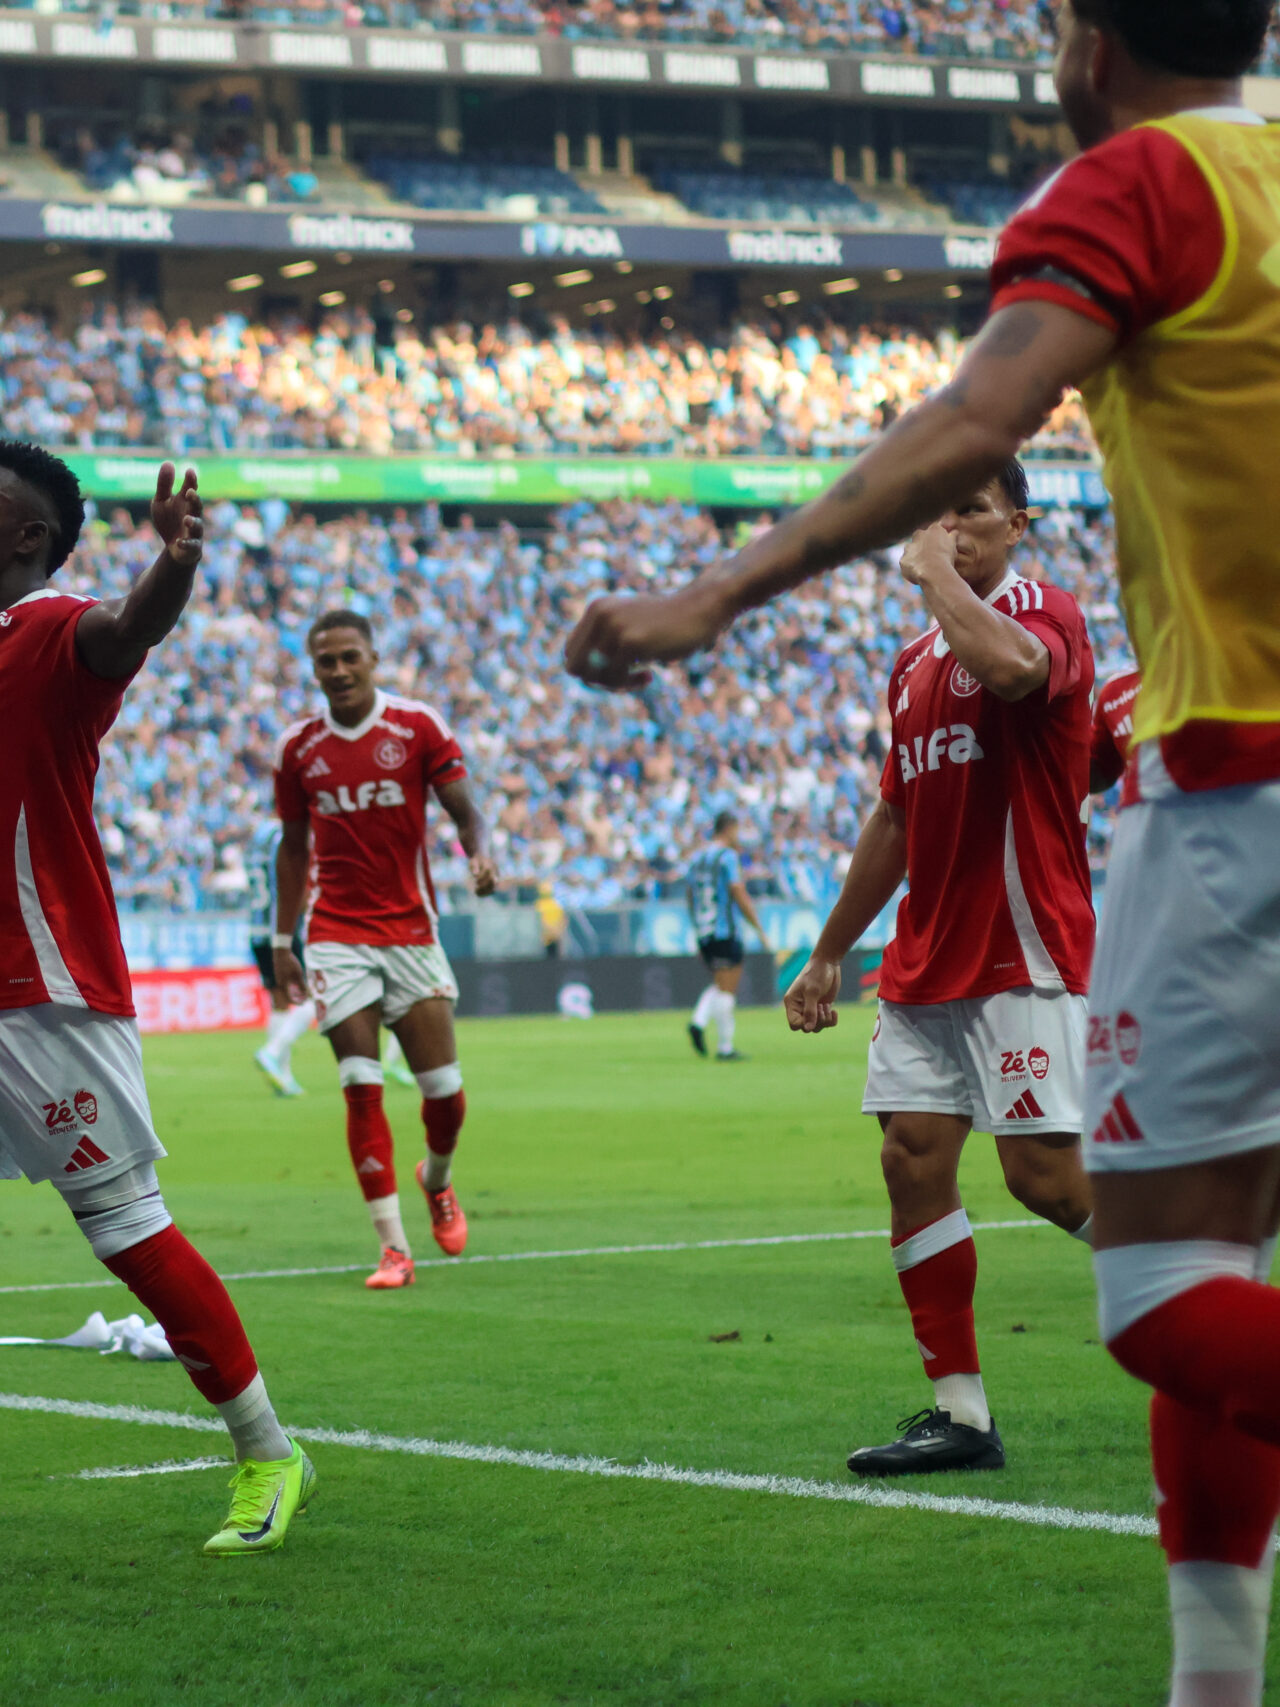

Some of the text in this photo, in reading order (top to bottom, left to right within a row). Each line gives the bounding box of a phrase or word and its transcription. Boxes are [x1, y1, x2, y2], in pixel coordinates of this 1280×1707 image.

[315, 779, 406, 815] alfa
[132, 979, 260, 1032] ERBE
[1000, 1049, 1026, 1075] Zé
[42, 1098, 75, 1128] Zé
